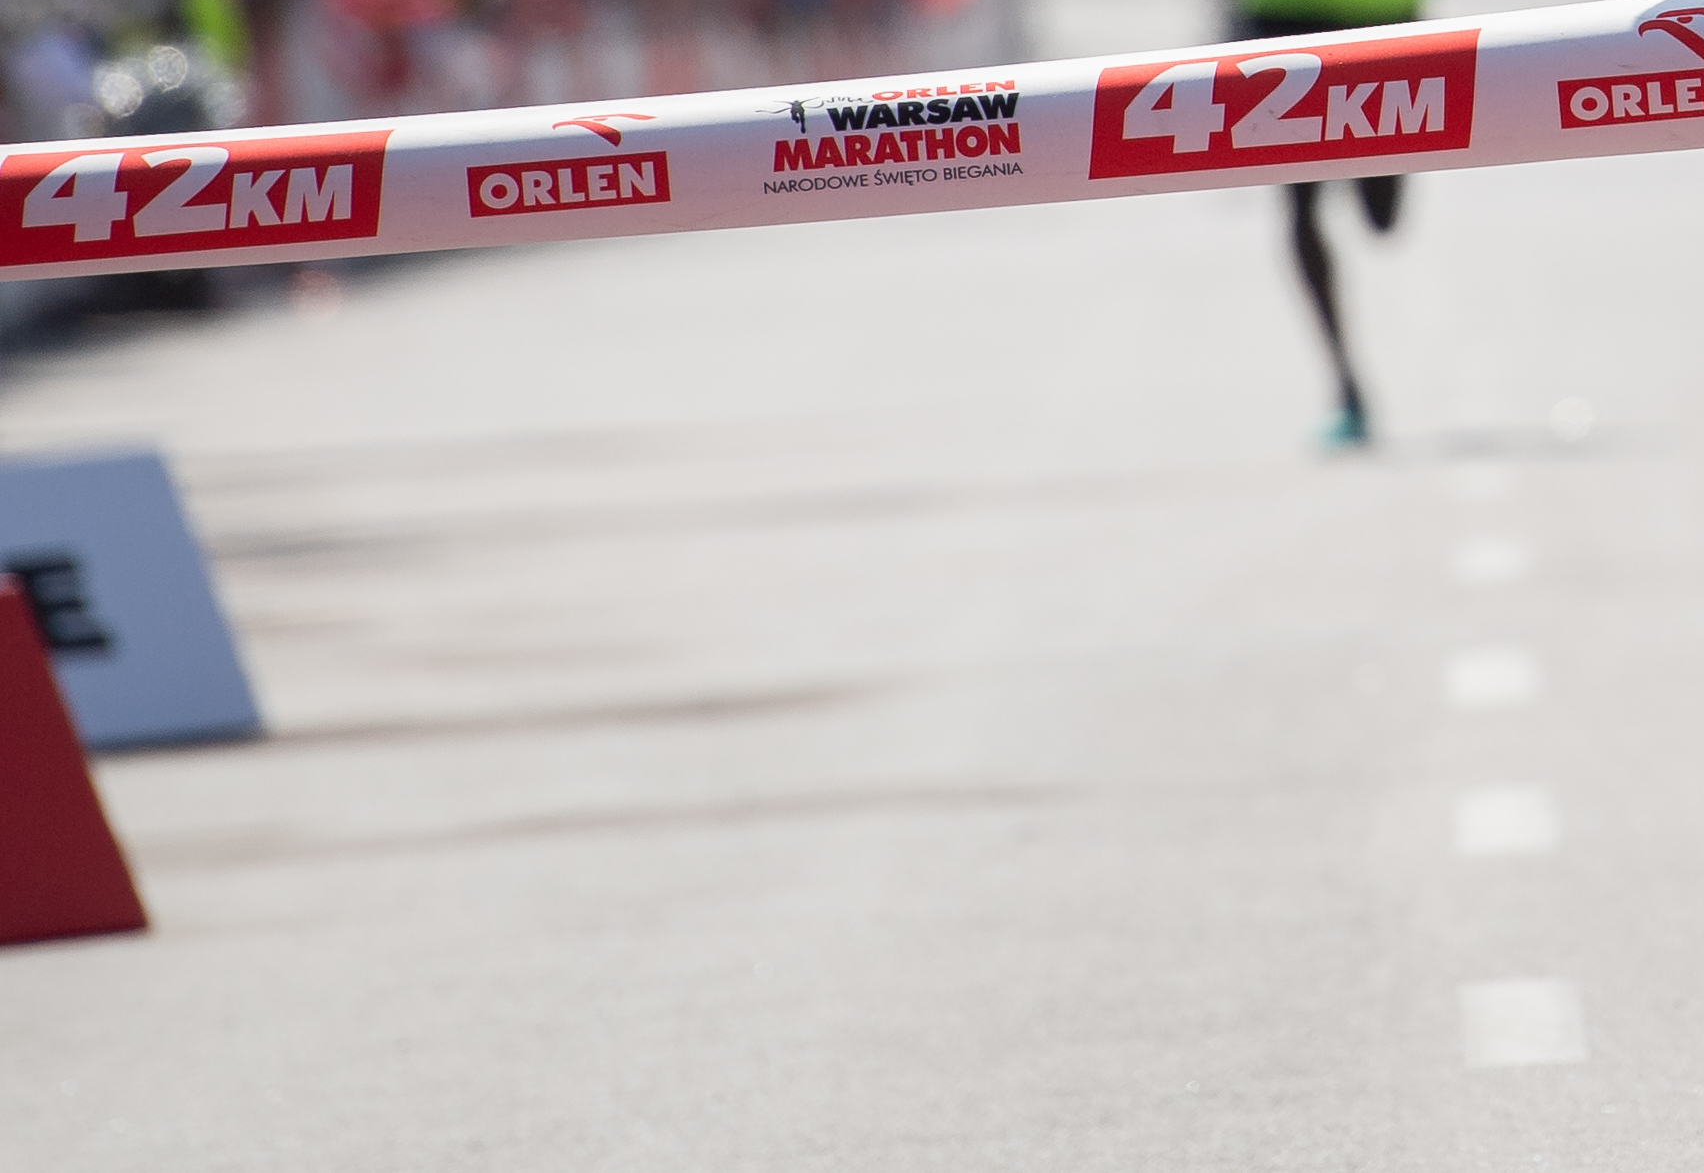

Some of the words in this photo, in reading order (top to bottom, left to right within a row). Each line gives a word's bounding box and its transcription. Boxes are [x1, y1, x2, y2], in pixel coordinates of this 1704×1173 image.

[872, 80, 1015, 101] ORLEN
[826, 93, 1019, 131] WARSAW
[773, 123, 1021, 172] MARATHON
[479, 161, 656, 209] ORLEN
[763, 174, 868, 194] NARODOWE
[874, 169, 937, 187] ŚWIĘTO
[943, 162, 1023, 181] BIEGANIA
